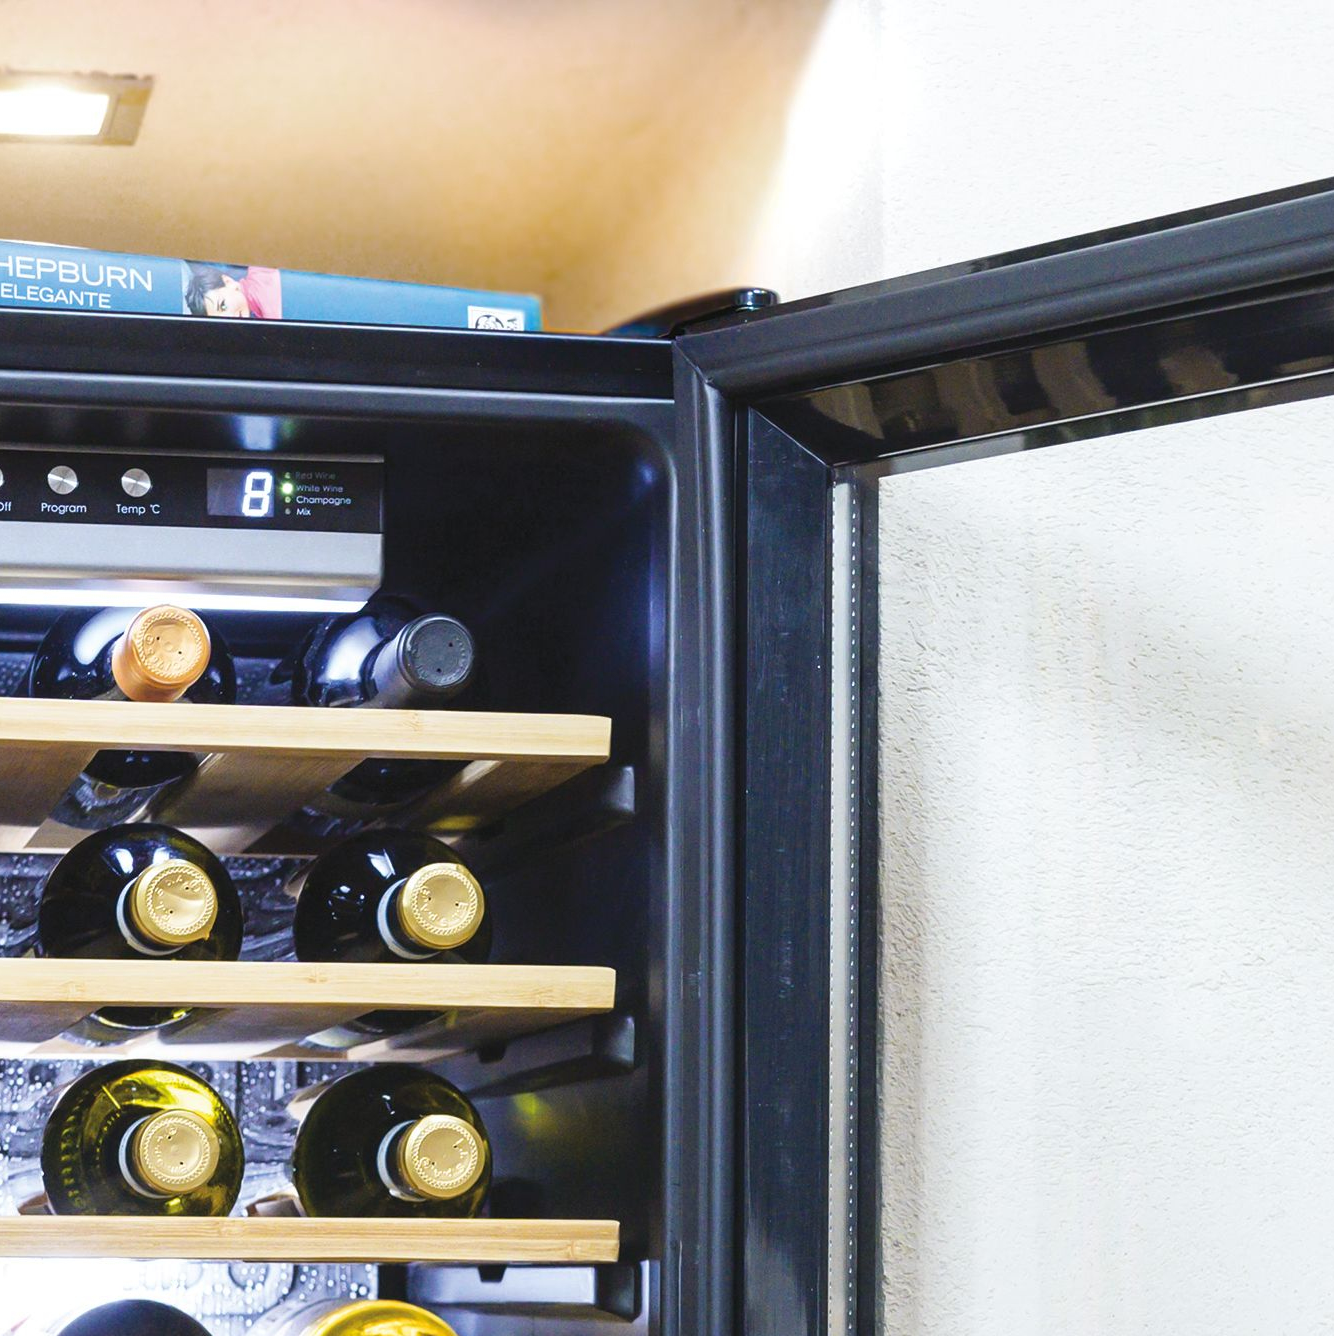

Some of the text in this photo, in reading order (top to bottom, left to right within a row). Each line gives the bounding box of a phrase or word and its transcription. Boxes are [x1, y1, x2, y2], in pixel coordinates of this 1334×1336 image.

[0, 282, 112, 309] ELEGANTE
[242, 471, 273, 517] 8
[296, 484, 320, 492] White
[296, 495, 352, 506] Champagne
[41, 502, 87, 515] Program
[116, 503, 146, 516] Temp
[296, 507, 311, 516] Mix
